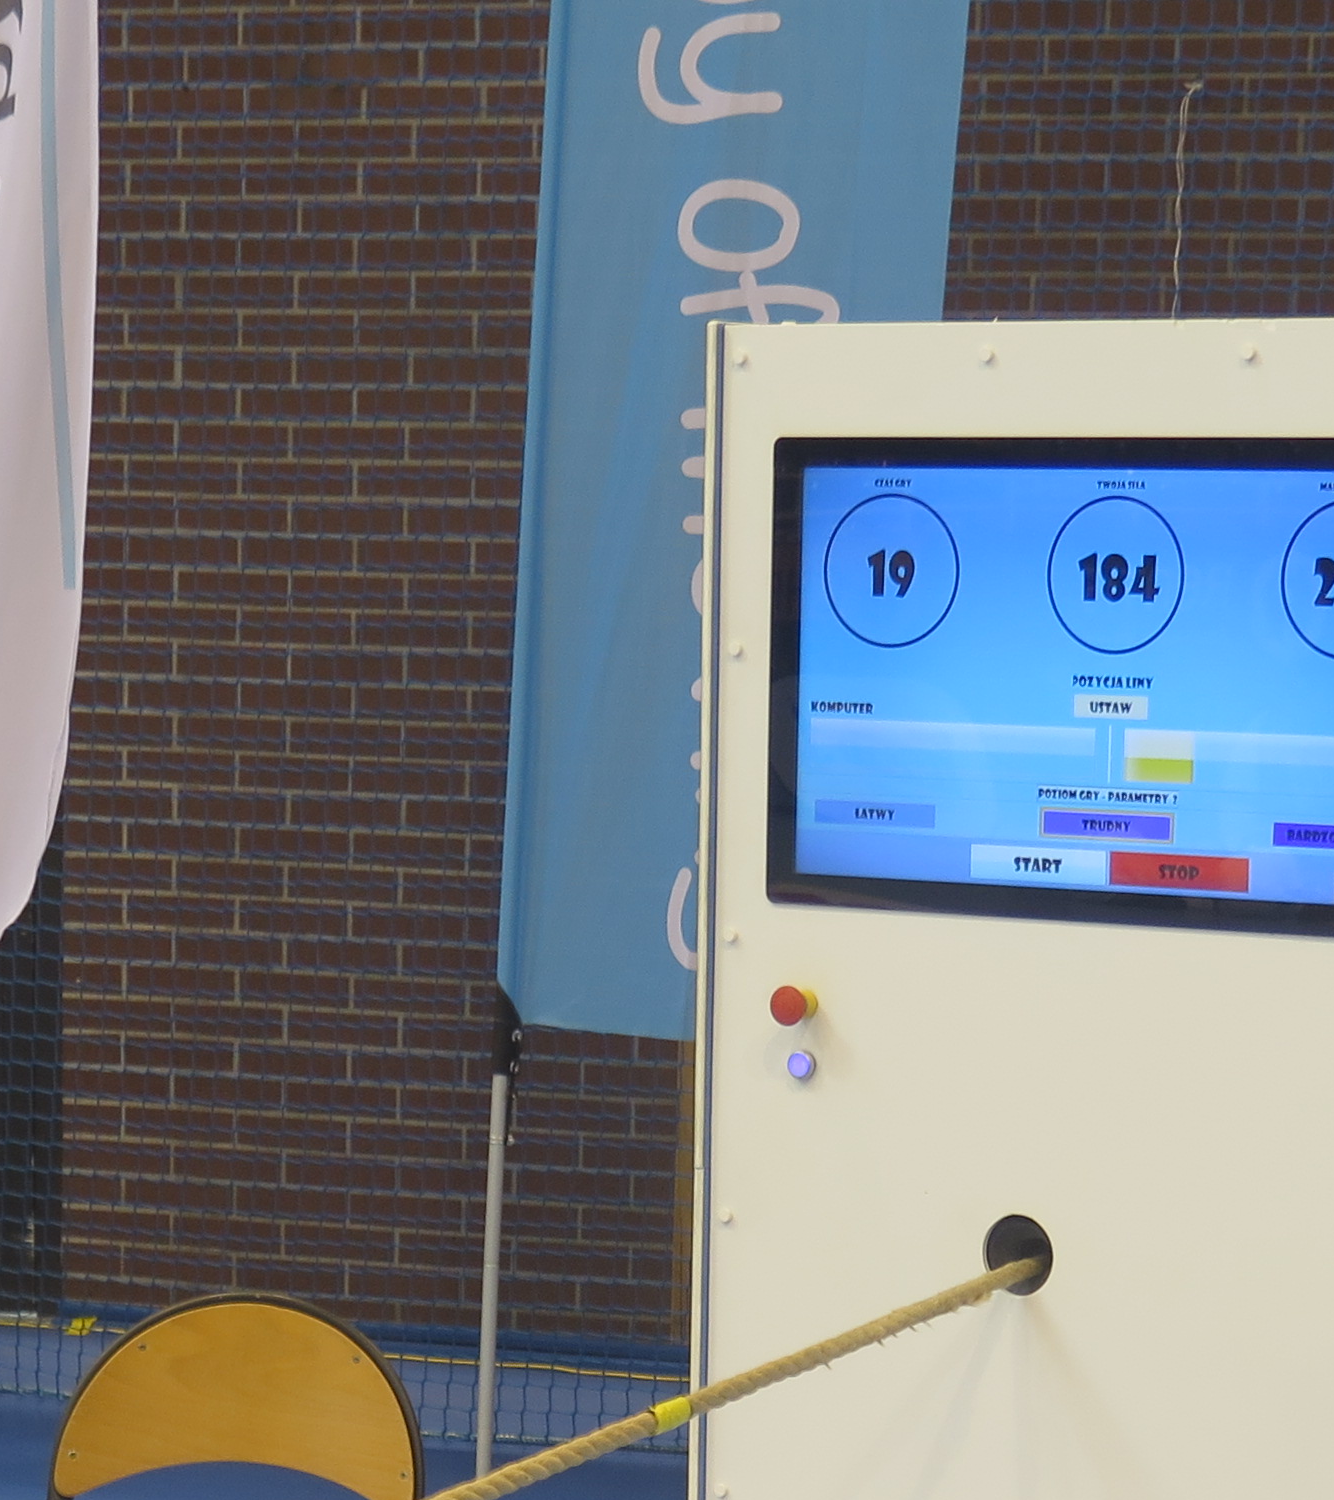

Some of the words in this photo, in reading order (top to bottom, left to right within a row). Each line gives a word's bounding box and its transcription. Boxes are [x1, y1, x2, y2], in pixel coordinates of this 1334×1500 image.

[867, 549, 916, 598] 19
[1077, 552, 1160, 603] 184
[1072, 675, 1123, 689] POZYCJA
[1125, 676, 1154, 689] LINY
[810, 700, 873, 714] KOMPUTER
[1089, 701, 1133, 714] USTAW
[1038, 788, 1077, 800] POZIOM
[1079, 790, 1100, 801] GRY
[1107, 792, 1169, 804] PARAMETRY
[1082, 819, 1131, 832] TRUDNY
[1013, 856, 1062, 874] START
[1158, 864, 1199, 880] STOP
